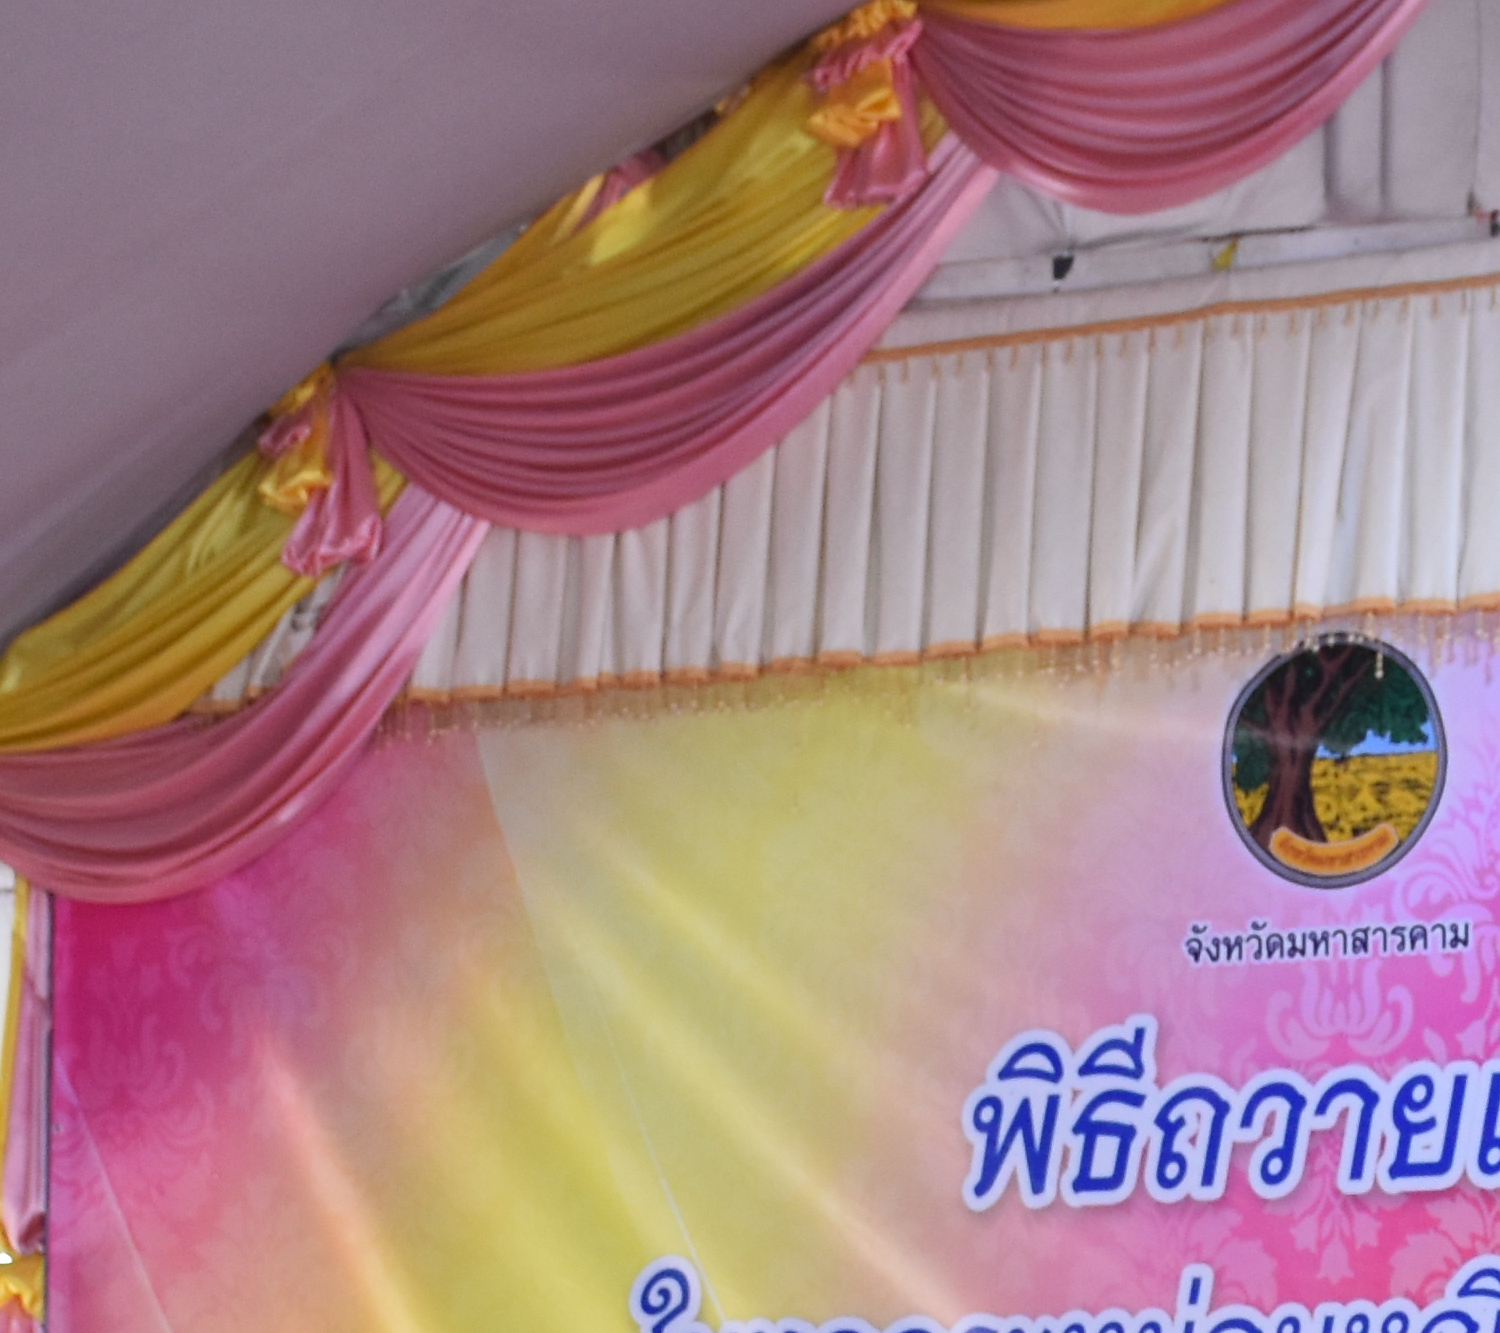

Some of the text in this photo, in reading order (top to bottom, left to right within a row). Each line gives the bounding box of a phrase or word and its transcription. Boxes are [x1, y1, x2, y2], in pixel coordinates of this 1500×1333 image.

[1185, 923, 1470, 963] จังหวัดมหาสารคาม
